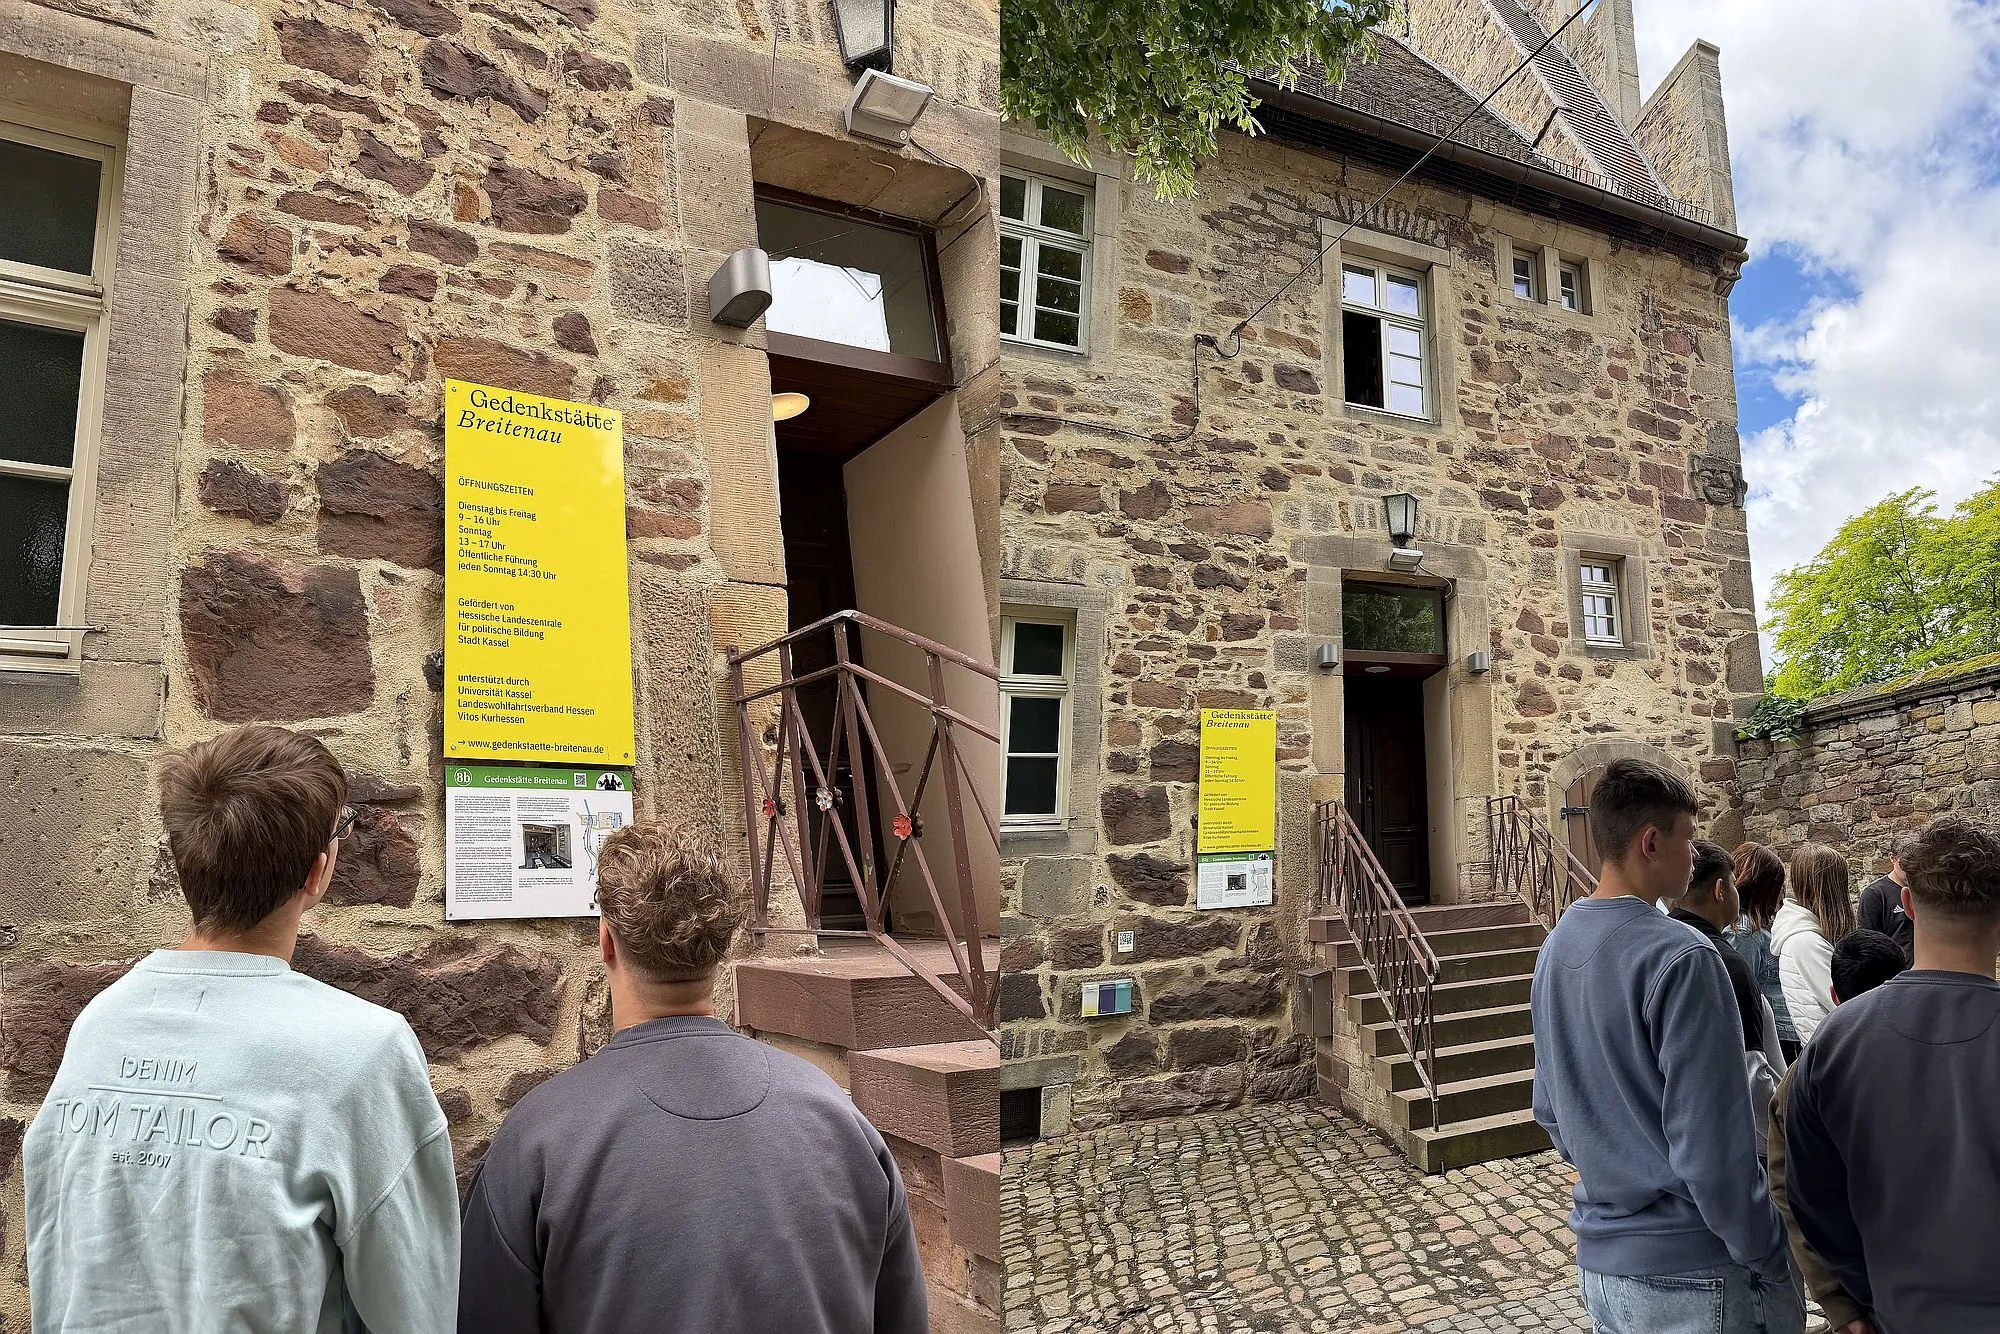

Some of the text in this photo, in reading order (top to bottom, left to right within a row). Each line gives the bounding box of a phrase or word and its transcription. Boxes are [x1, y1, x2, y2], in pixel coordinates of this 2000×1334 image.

[471, 389, 613, 431] Gedenkstätte
[457, 410, 562, 444] Breitenau
[458, 476, 534, 497] ÖFFNUNGSZEITEN
[458, 502, 537, 521] Dienstag bis Freitag
[459, 513, 464, 522] 9
[474, 515, 484, 524] 16
[486, 517, 500, 526] Uhr
[458, 525, 492, 539] Sonntag
[459, 537, 469, 546] 13
[479, 539, 490, 549] 17
[491, 541, 506, 551] Uhr
[458, 549, 538, 568] Öffentliche Führung
[458, 561, 557, 580] jeden Sonntag 14:30 Uhr
[458, 598, 515, 611] Gefördert von
[458, 611, 562, 628] Hessische Landeszentrale
[458, 622, 544, 640] für politische Bildung
[458, 635, 510, 648] Stadt Kassel
[458, 674, 530, 686] unterstützt durch
[458, 686, 532, 699] Universität Kassel
[458, 699, 595, 716] Landeswohlfahrtsverband Hessen
[458, 712, 525, 724] Vitos Kurhessen
[1206, 720, 1250, 728] Breitenau
[468, 739, 604, 754] www.gedenkstaette-breitenau.de
[456, 772, 568, 785] 8b Gedenkstätte Breitenau
[120, 1056, 199, 1083] DENIM
[56, 1097, 273, 1159] TOM TAILOR
[112, 1150, 172, 1169] est. 2007
